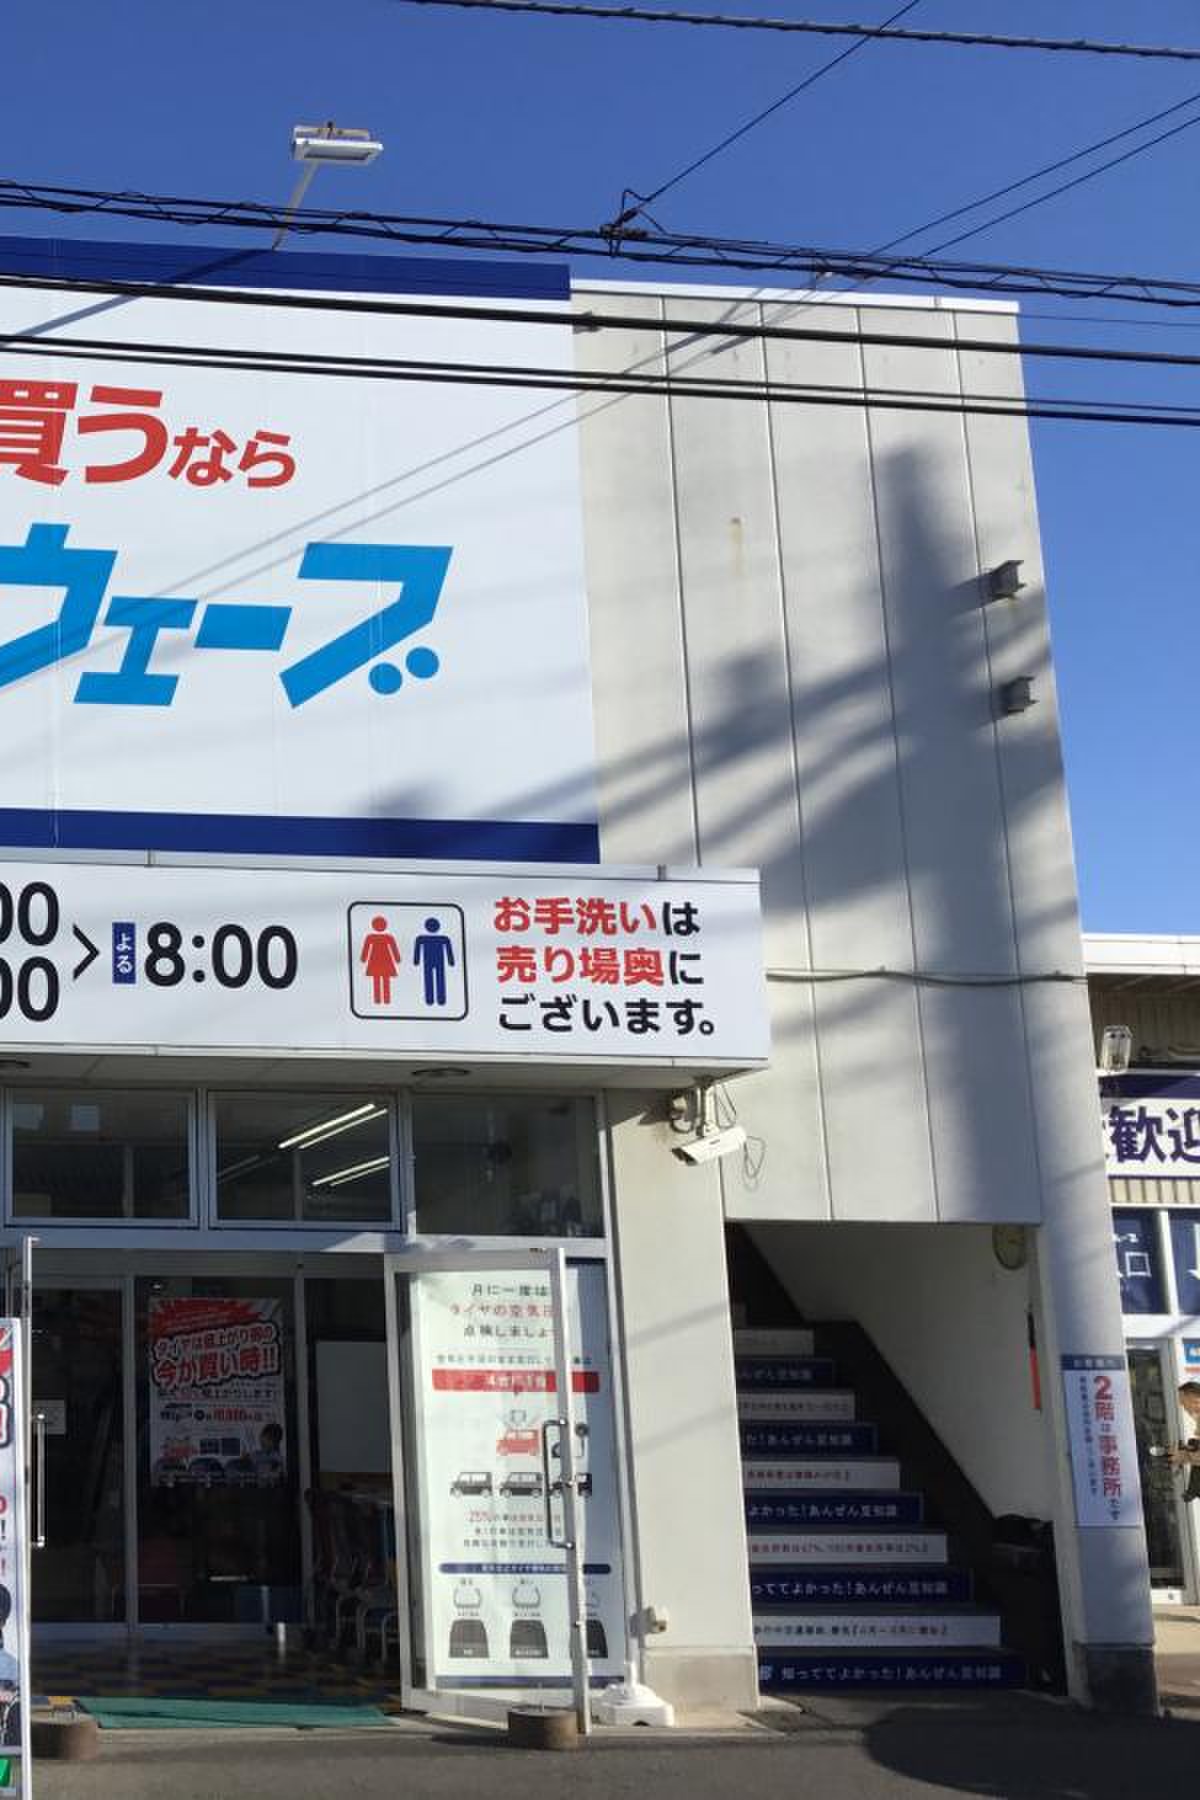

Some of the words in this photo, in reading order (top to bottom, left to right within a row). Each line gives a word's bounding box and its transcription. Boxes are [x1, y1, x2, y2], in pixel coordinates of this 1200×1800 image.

[493, 896, 701, 937] お手洗いは
[115, 927, 136, 978] よる
[144, 920, 299, 990] 8:00
[496, 946, 704, 986] 売り場奥に
[497, 997, 717, 1035] ございます。
